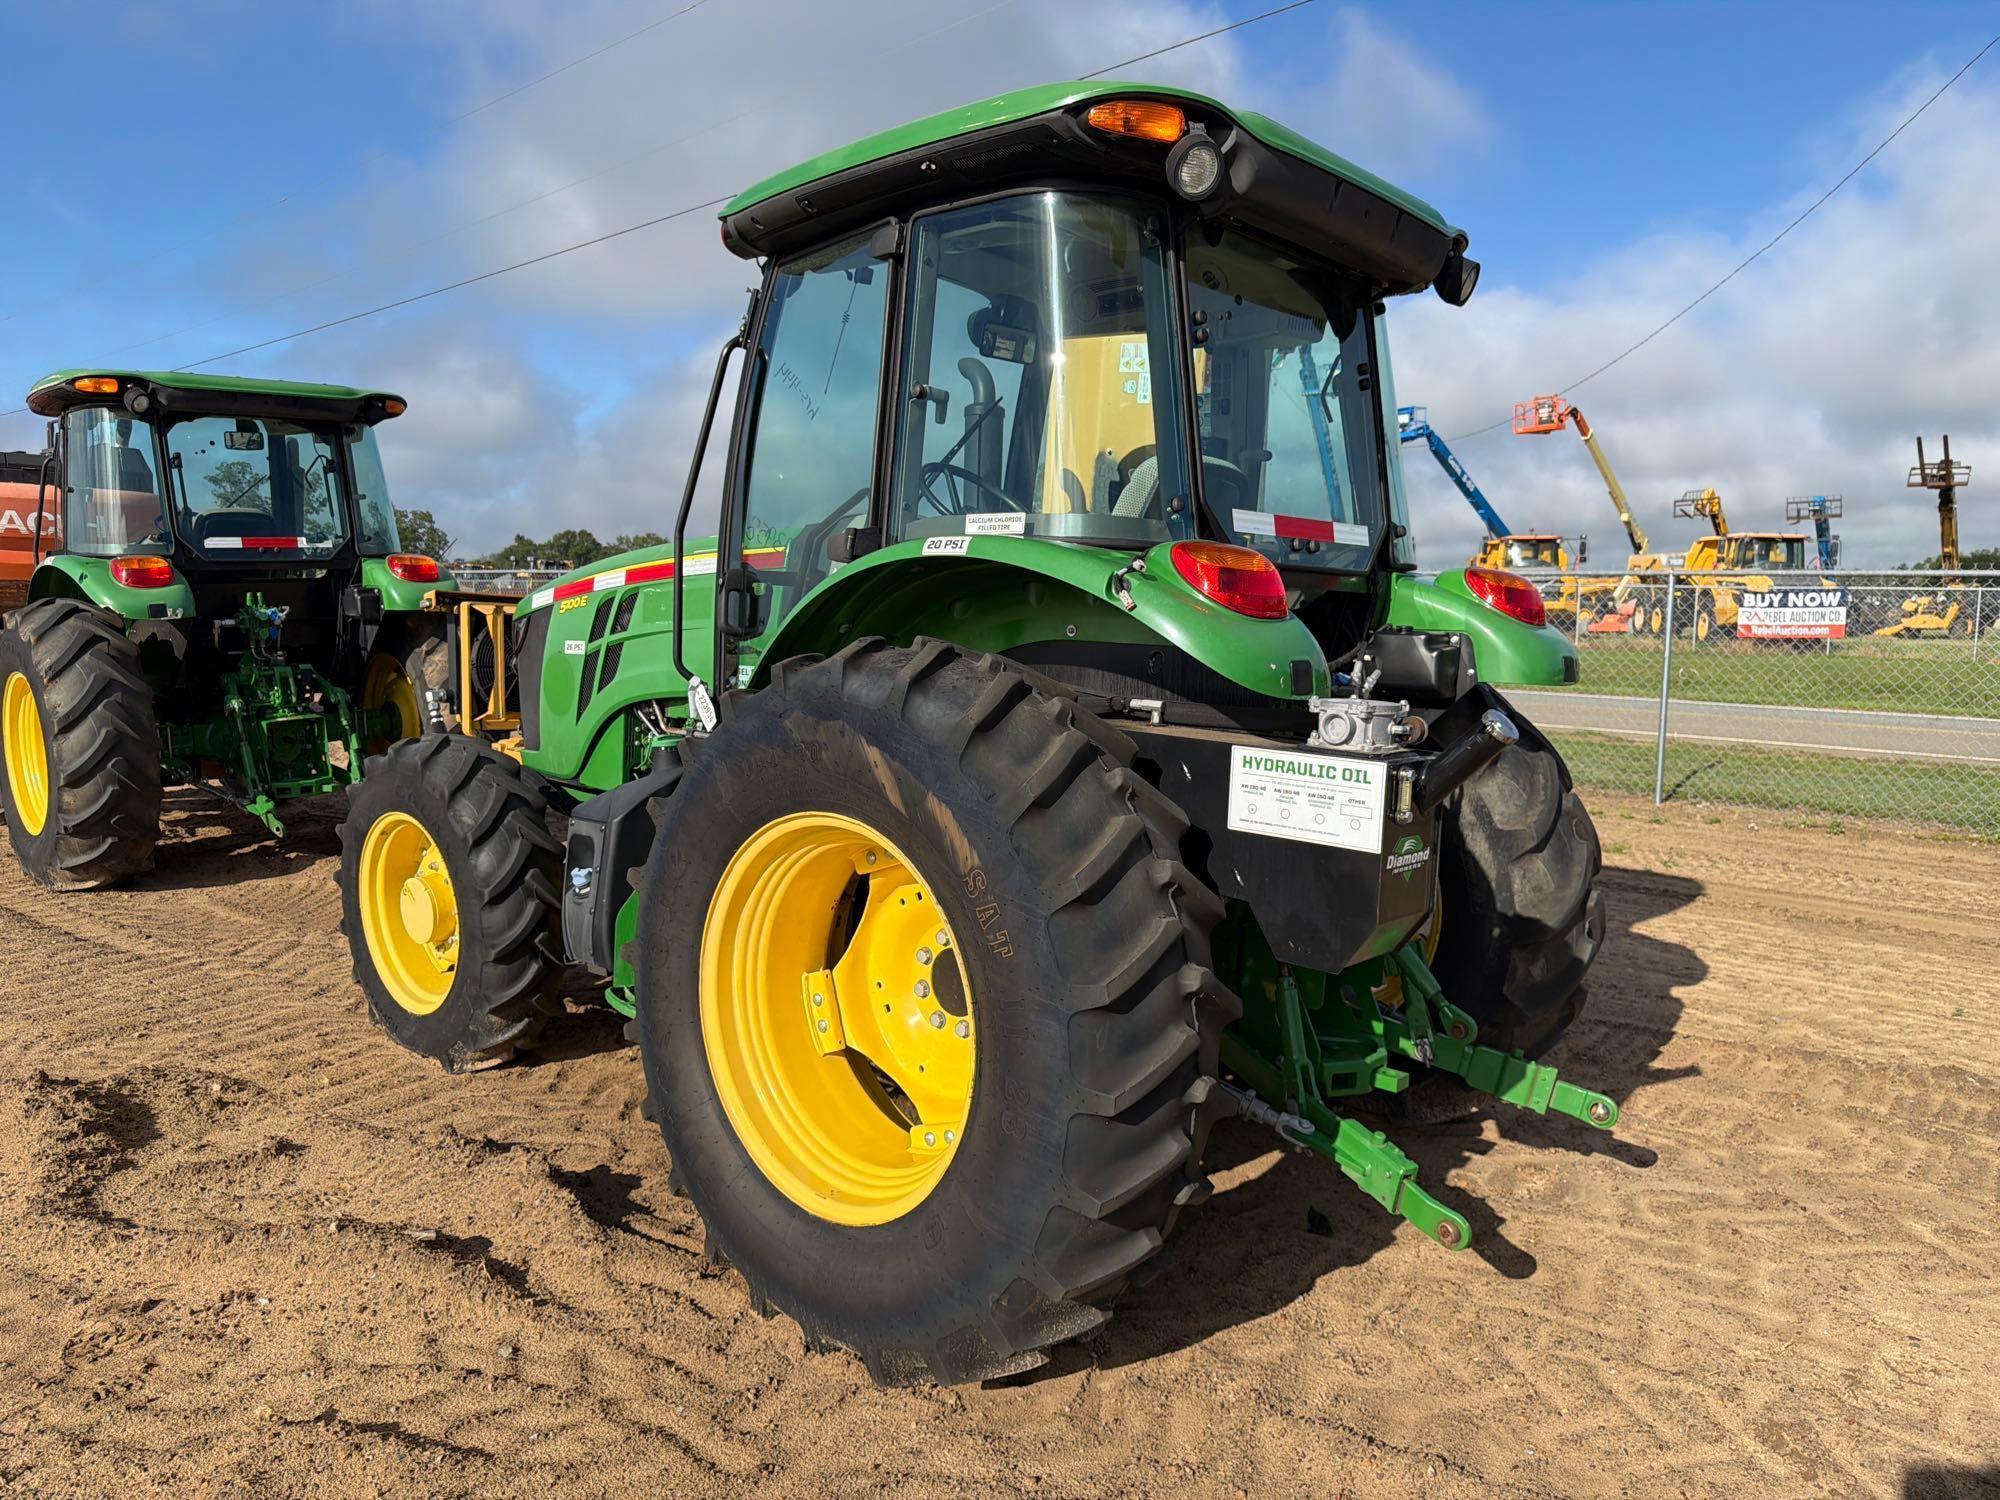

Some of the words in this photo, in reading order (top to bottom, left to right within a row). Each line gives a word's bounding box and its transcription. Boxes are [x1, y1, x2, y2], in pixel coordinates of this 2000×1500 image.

[927, 540, 942, 549] 20
[944, 539, 967, 549] PSI
[1743, 593, 1784, 608] BUY
[1788, 592, 1842, 607] NOW
[1789, 610, 1827, 623] AUCTION
[1242, 755, 1337, 780] HYDRAULIC
[1341, 767, 1372, 785] OIL
[1386, 846, 1430, 870] Diamond
